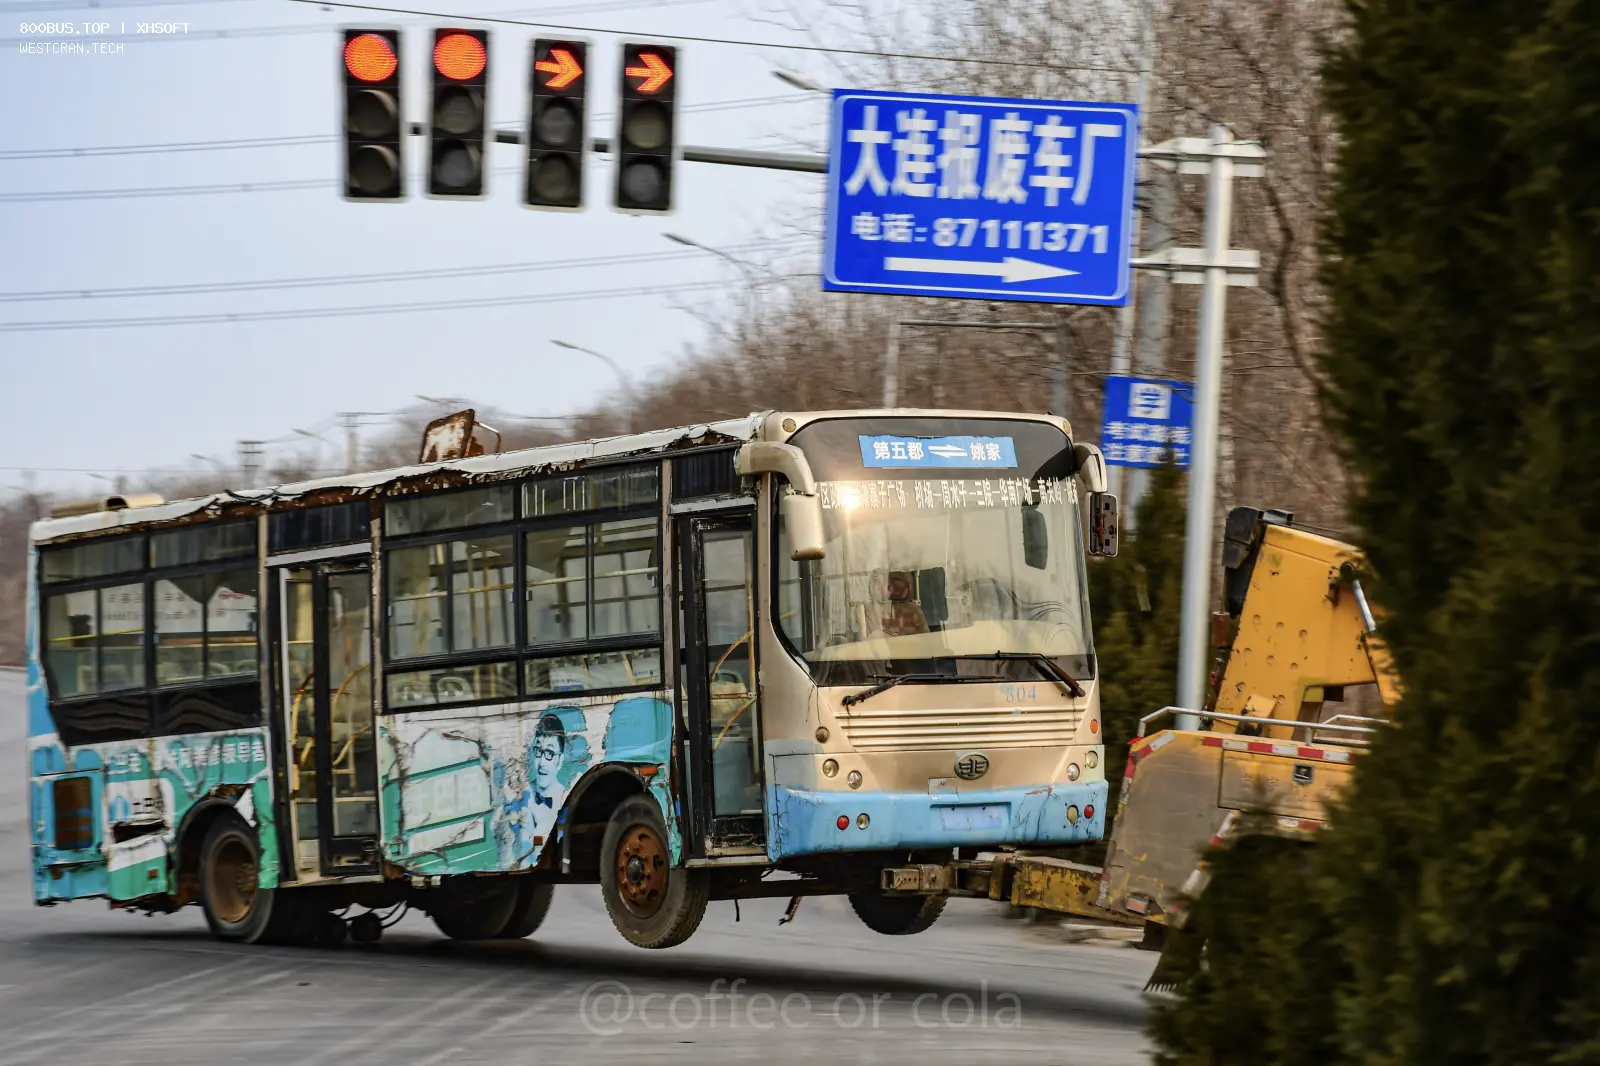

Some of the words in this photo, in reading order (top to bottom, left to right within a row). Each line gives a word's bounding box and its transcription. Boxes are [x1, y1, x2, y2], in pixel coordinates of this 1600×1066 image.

[843, 105, 1123, 207] 大连报废车厂
[872, 441, 925, 461] 第五郡
[969, 442, 1001, 461] 姚家
[1006, 685, 1037, 704] 804
